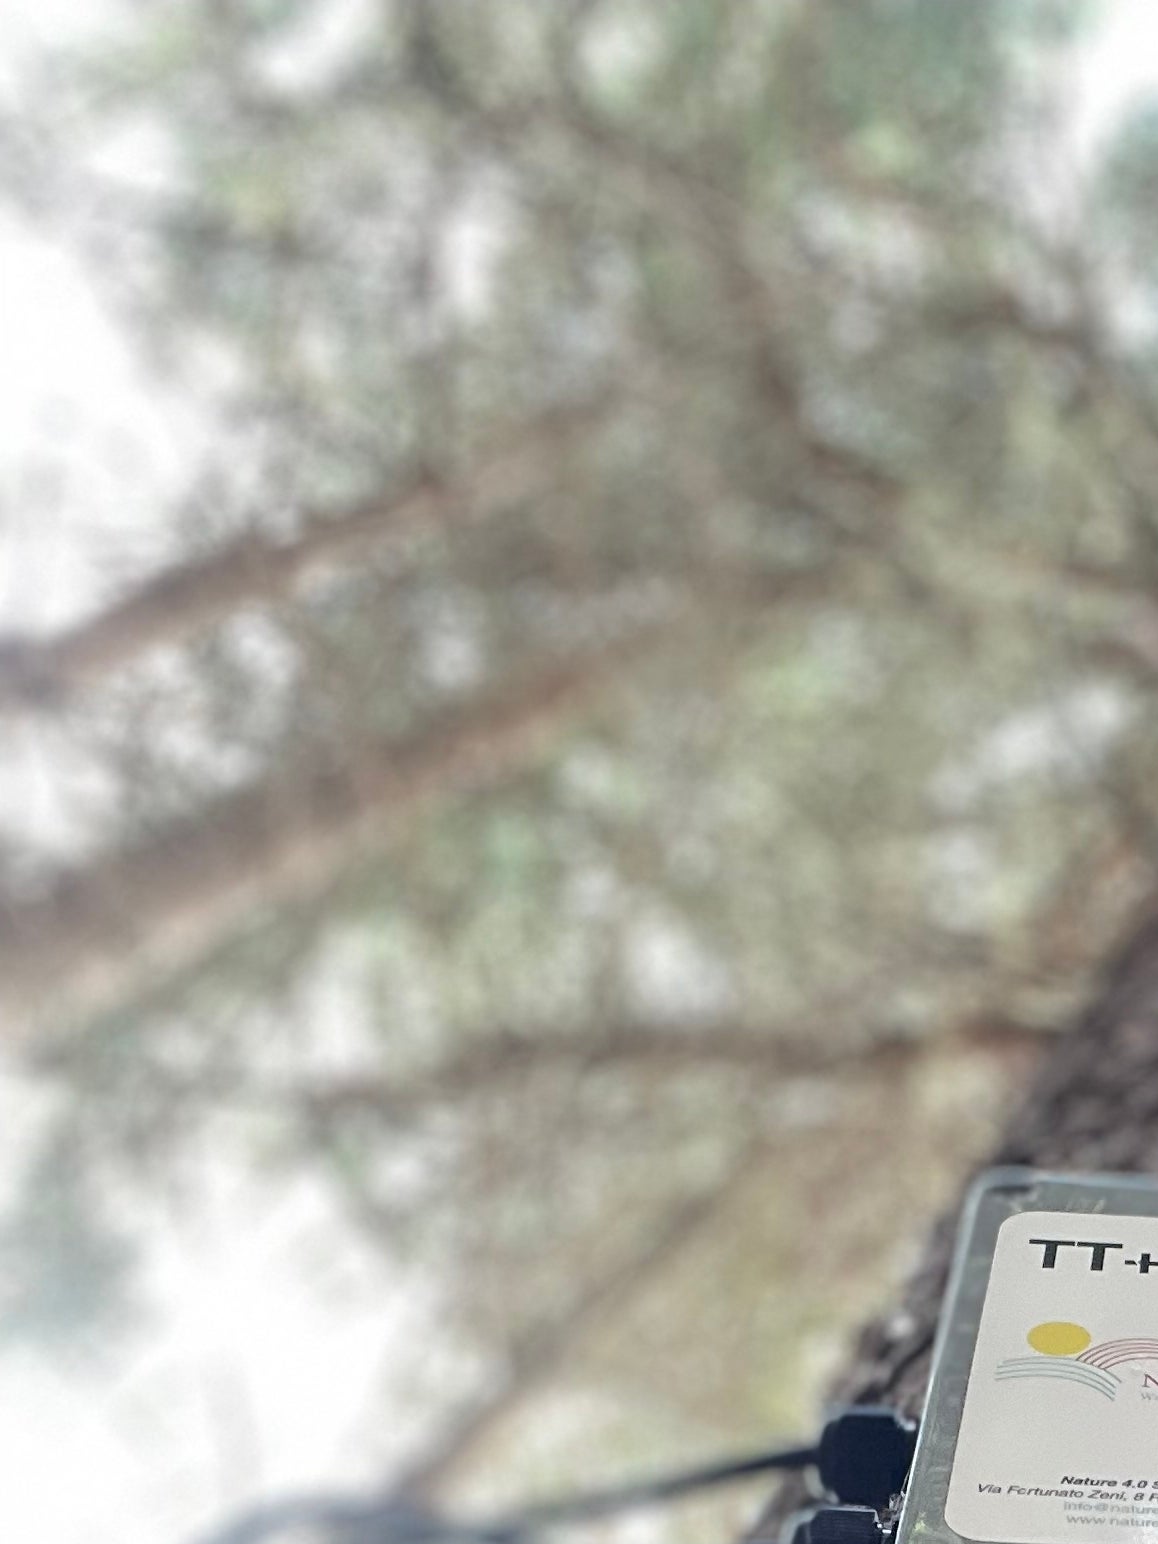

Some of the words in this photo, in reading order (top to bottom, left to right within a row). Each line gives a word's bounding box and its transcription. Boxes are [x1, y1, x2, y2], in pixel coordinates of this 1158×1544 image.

[1060, 1475, 1118, 1488] Nature
[1121, 1479, 1148, 1490] 4.0
[977, 1483, 1002, 1494] Via
[1007, 1485, 1084, 1499] Fortunato
[1133, 1492, 1145, 1502] 8
